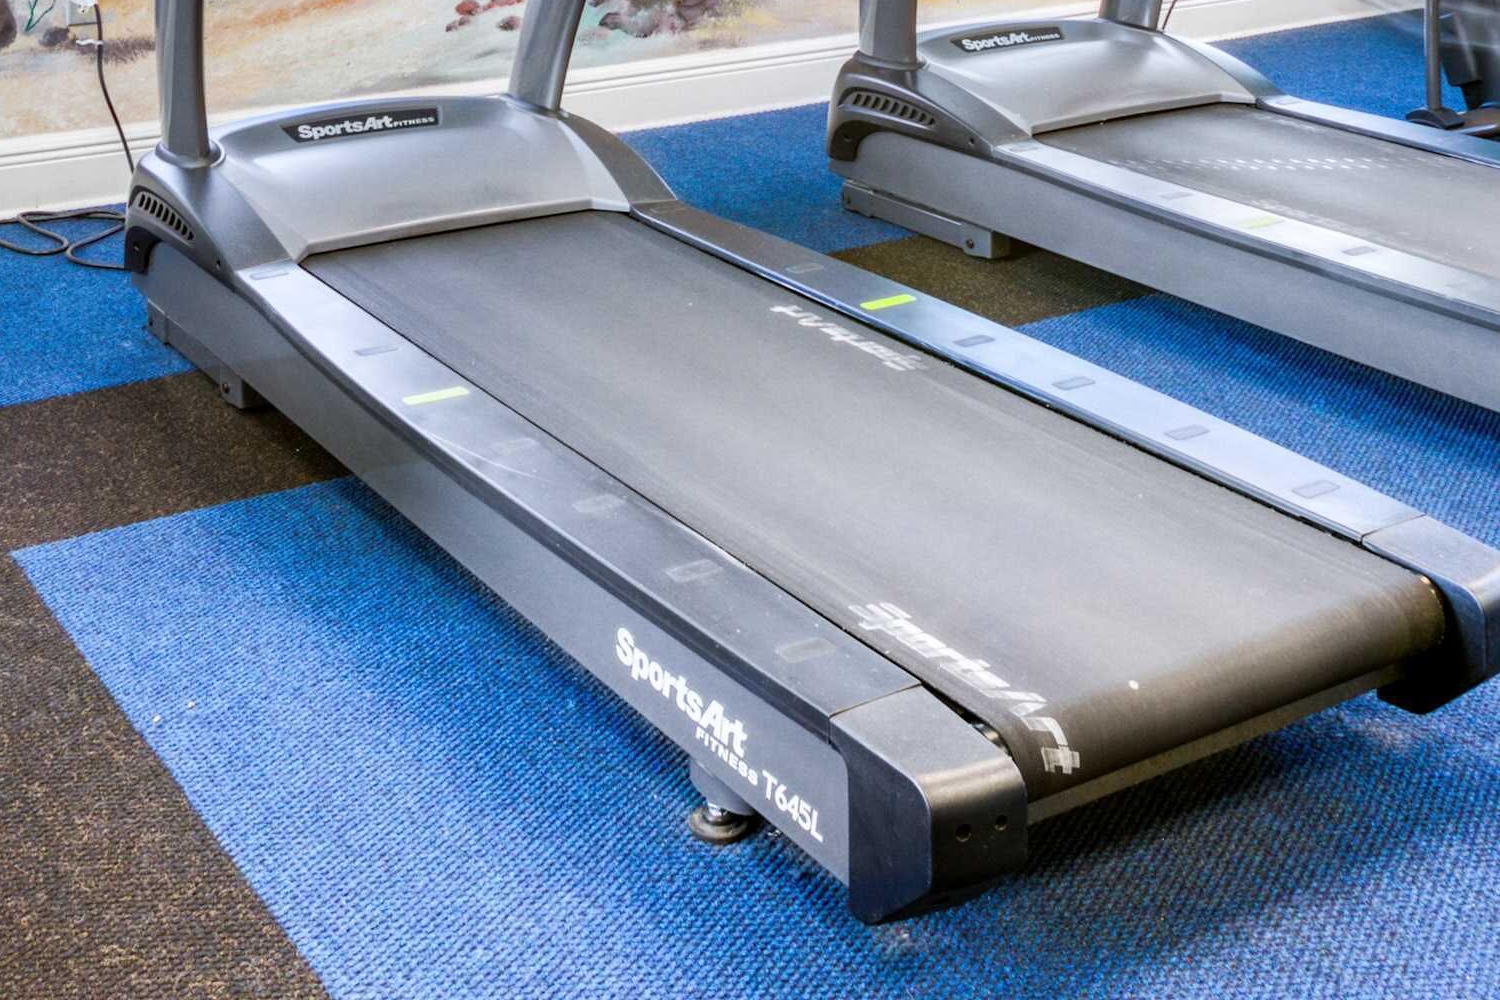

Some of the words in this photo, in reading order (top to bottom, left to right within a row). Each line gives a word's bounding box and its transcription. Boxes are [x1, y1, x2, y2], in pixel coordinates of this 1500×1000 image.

[962, 32, 1030, 51] SportsArt
[297, 115, 394, 140] SportsArt
[393, 116, 436, 129] FITNESS
[615, 627, 748, 758] SportsArt
[695, 726, 758, 787] FITNESS
[762, 769, 824, 843] T645L
